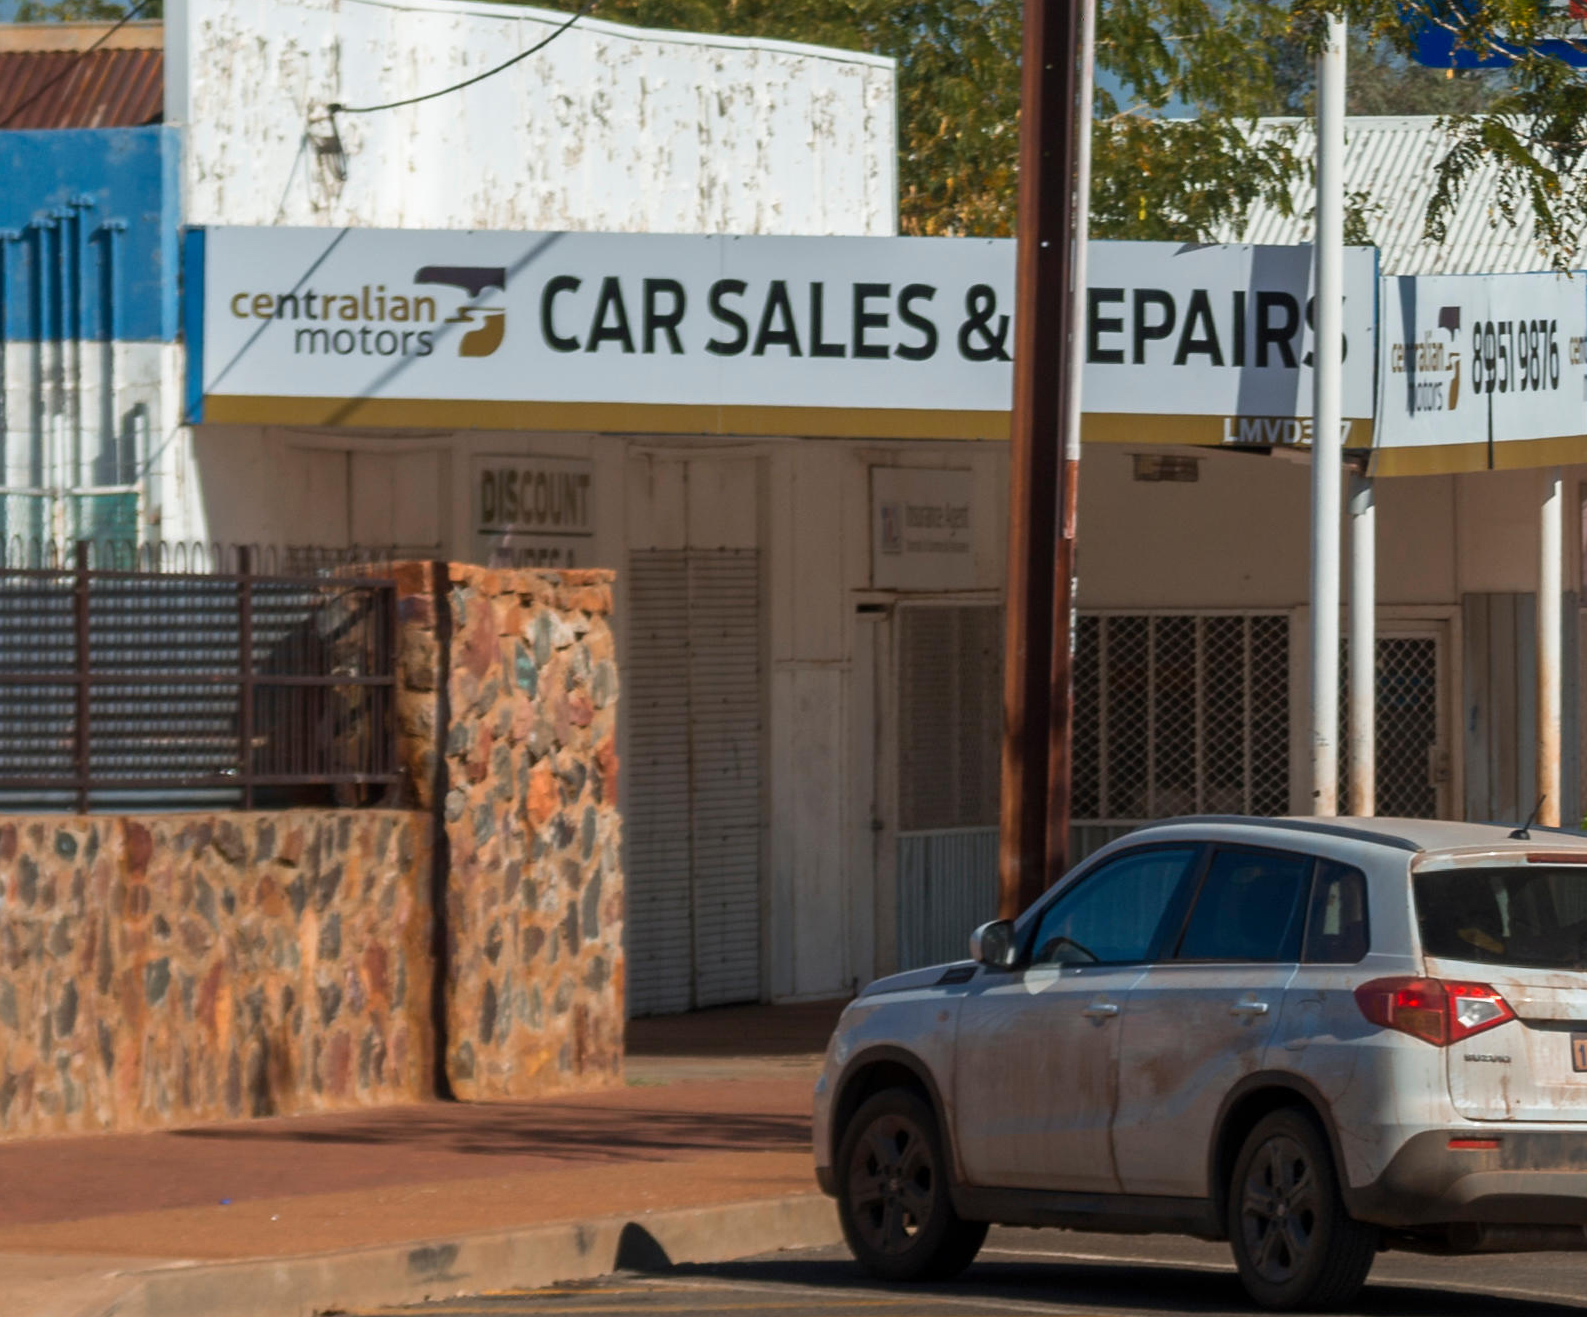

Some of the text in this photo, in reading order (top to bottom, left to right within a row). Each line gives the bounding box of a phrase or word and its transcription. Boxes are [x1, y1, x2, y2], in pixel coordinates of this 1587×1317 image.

[230, 283, 436, 323] centralian
[540, 275, 1348, 369] CAR SALES & EPAIR
[294, 326, 434, 358] motors
[1471, 320, 1516, 395] 8951
[1518, 318, 1560, 392] 9876
[1221, 416, 1353, 446] LMVD37
[481, 469, 591, 527] DISCOUNT
